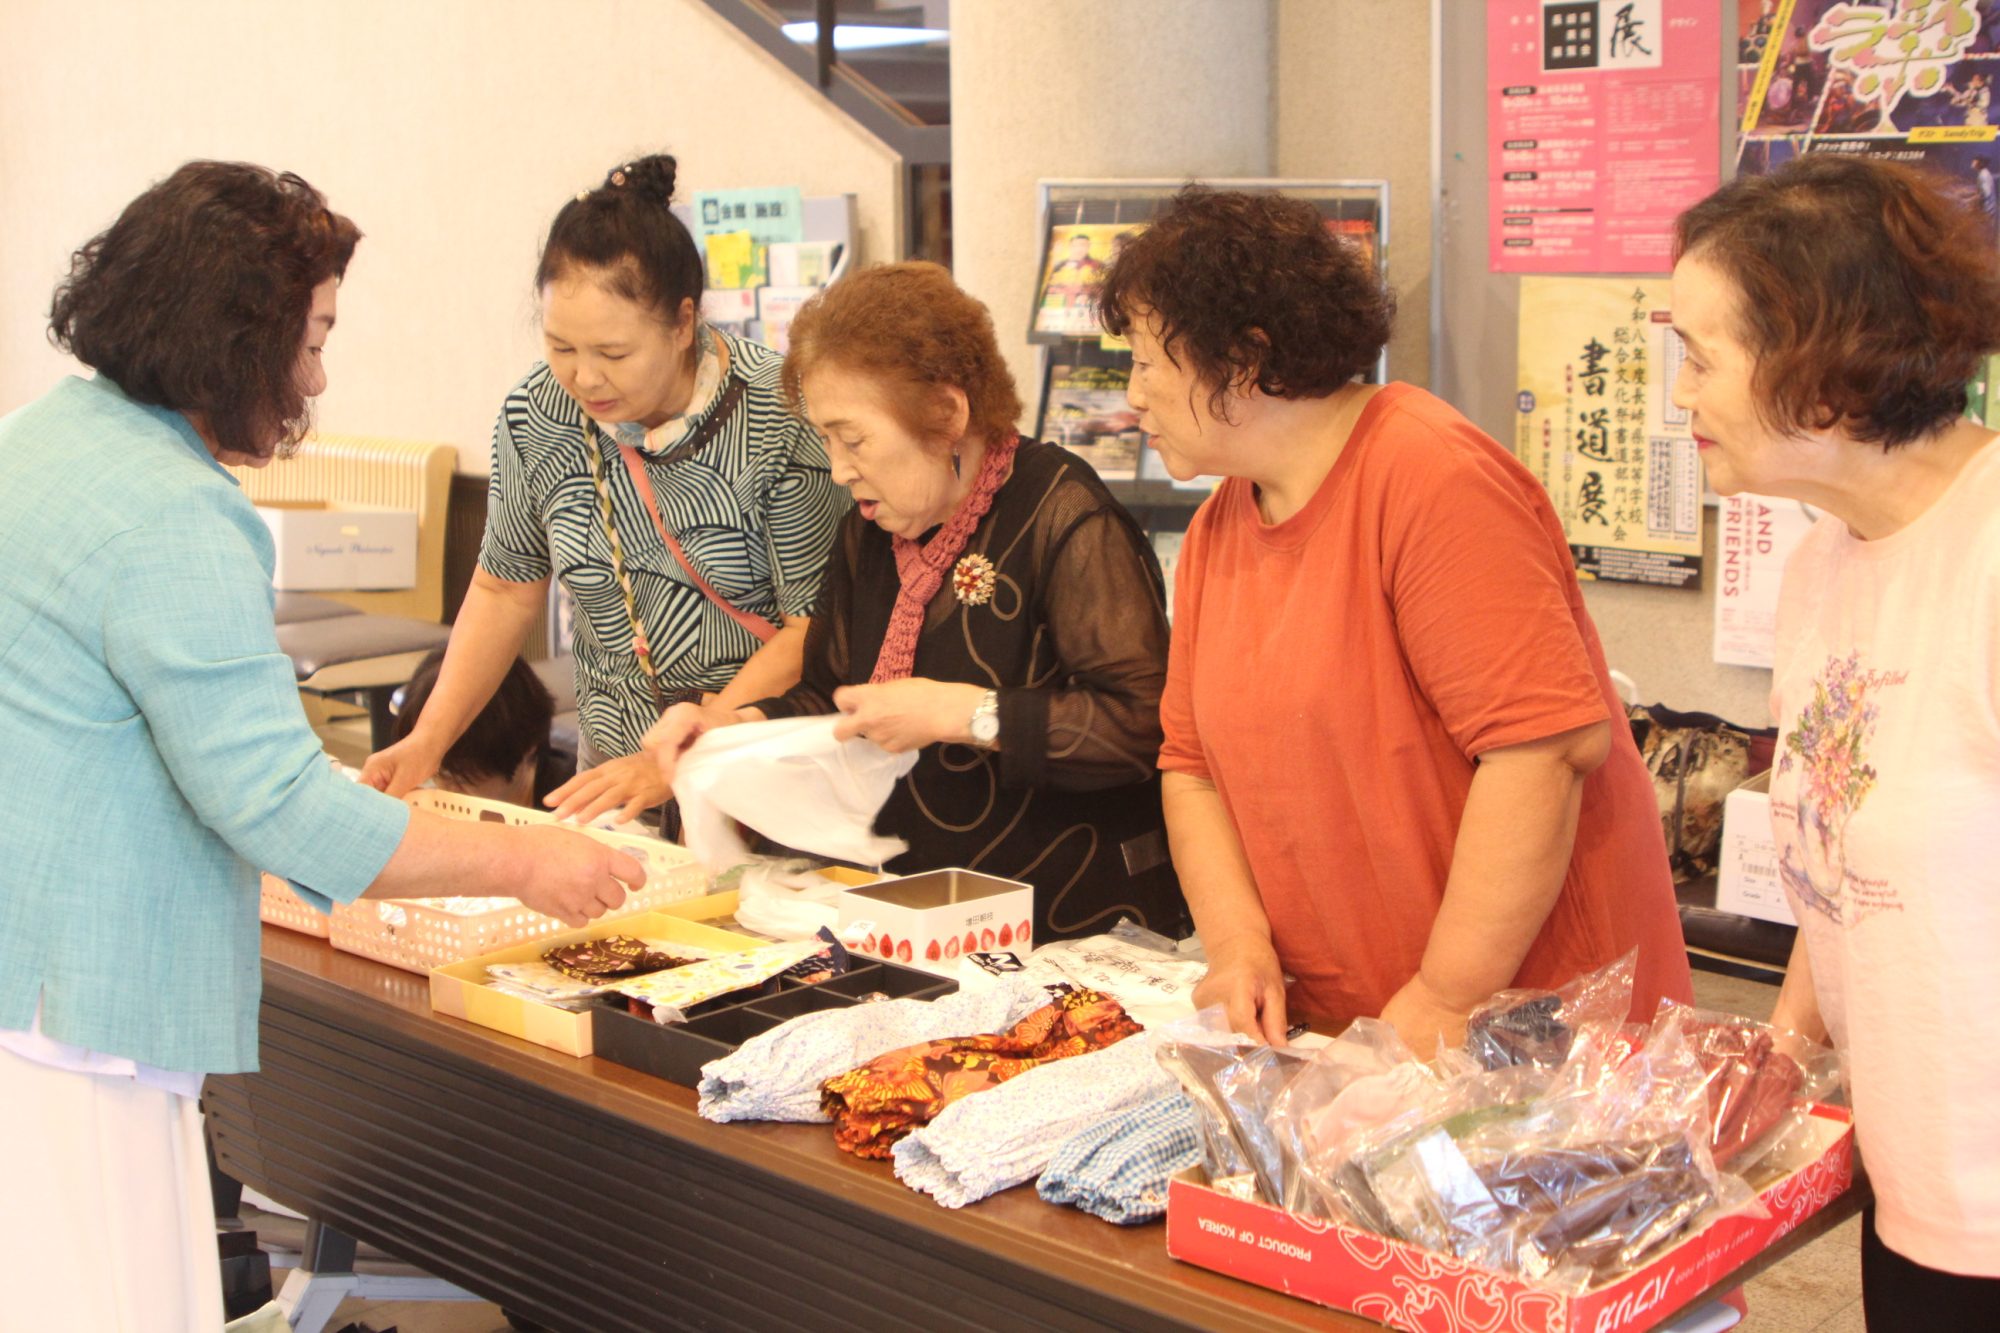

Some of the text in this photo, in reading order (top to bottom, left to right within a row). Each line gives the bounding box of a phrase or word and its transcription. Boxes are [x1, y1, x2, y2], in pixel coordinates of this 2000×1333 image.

[1610, 2, 1653, 58] 展
[1576, 336, 1613, 527] 書道展
[1723, 497, 1742, 598] FRIENDS
[1757, 503, 1773, 555] AND
[1197, 1217, 1312, 1263] PRODUCT OF KOREA
